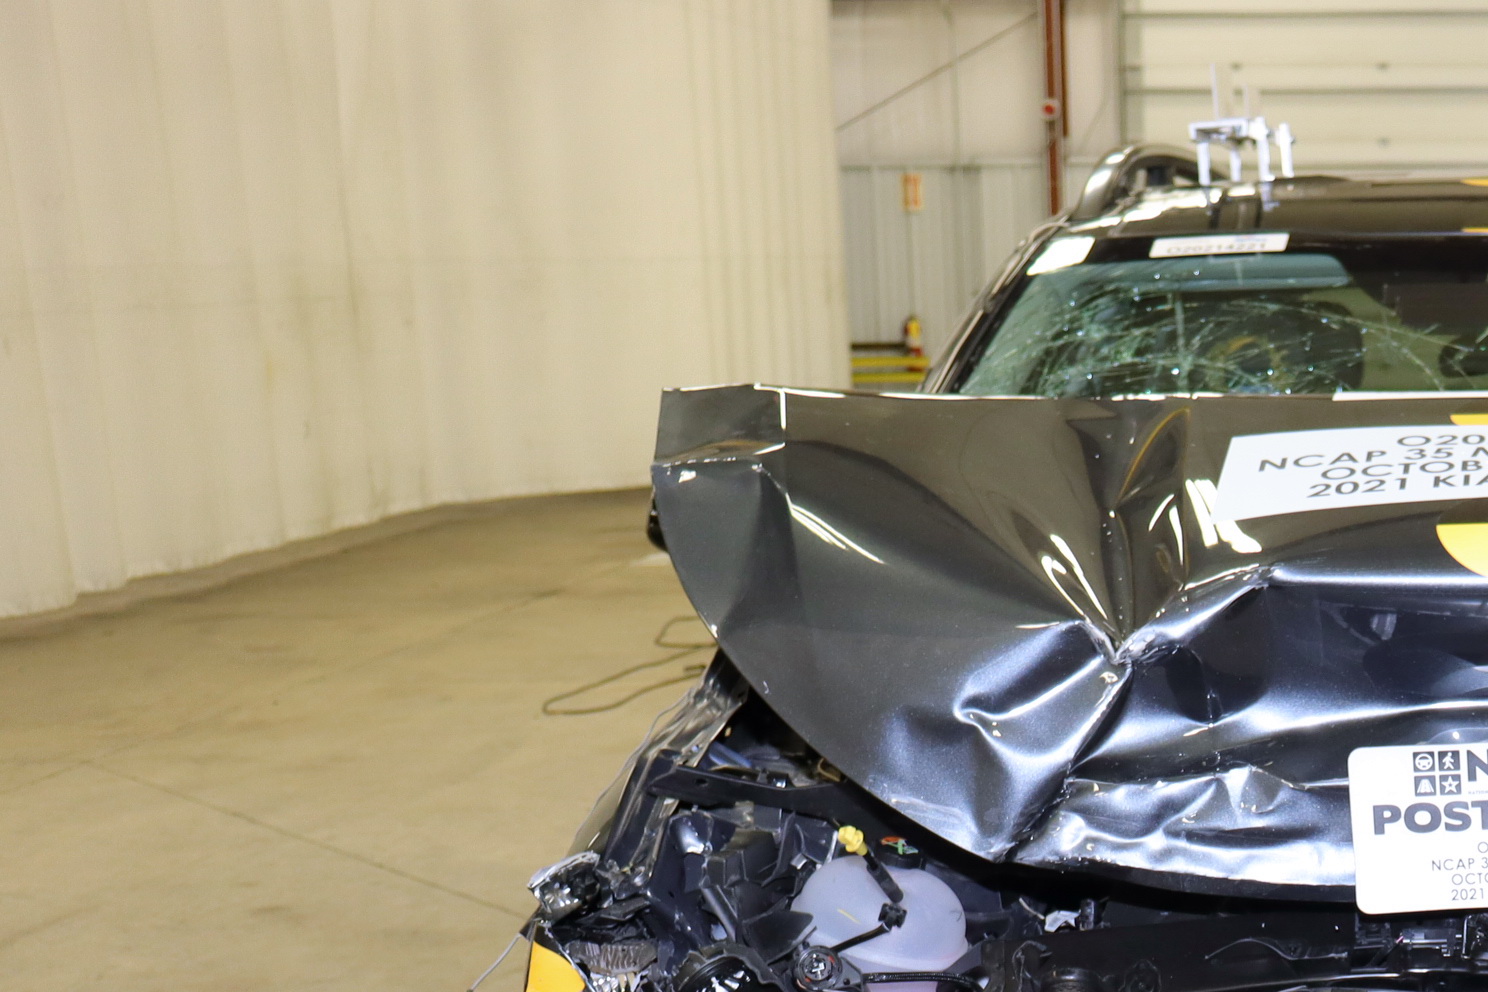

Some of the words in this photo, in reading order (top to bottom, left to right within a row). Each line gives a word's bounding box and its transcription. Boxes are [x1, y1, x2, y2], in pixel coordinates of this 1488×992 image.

[1258, 450, 1388, 473] NCAP
[1403, 447, 1455, 461] 35
[1306, 477, 1409, 498] 2021
[1432, 858, 1475, 872] NCAP
[1451, 887, 1485, 901] 2021
